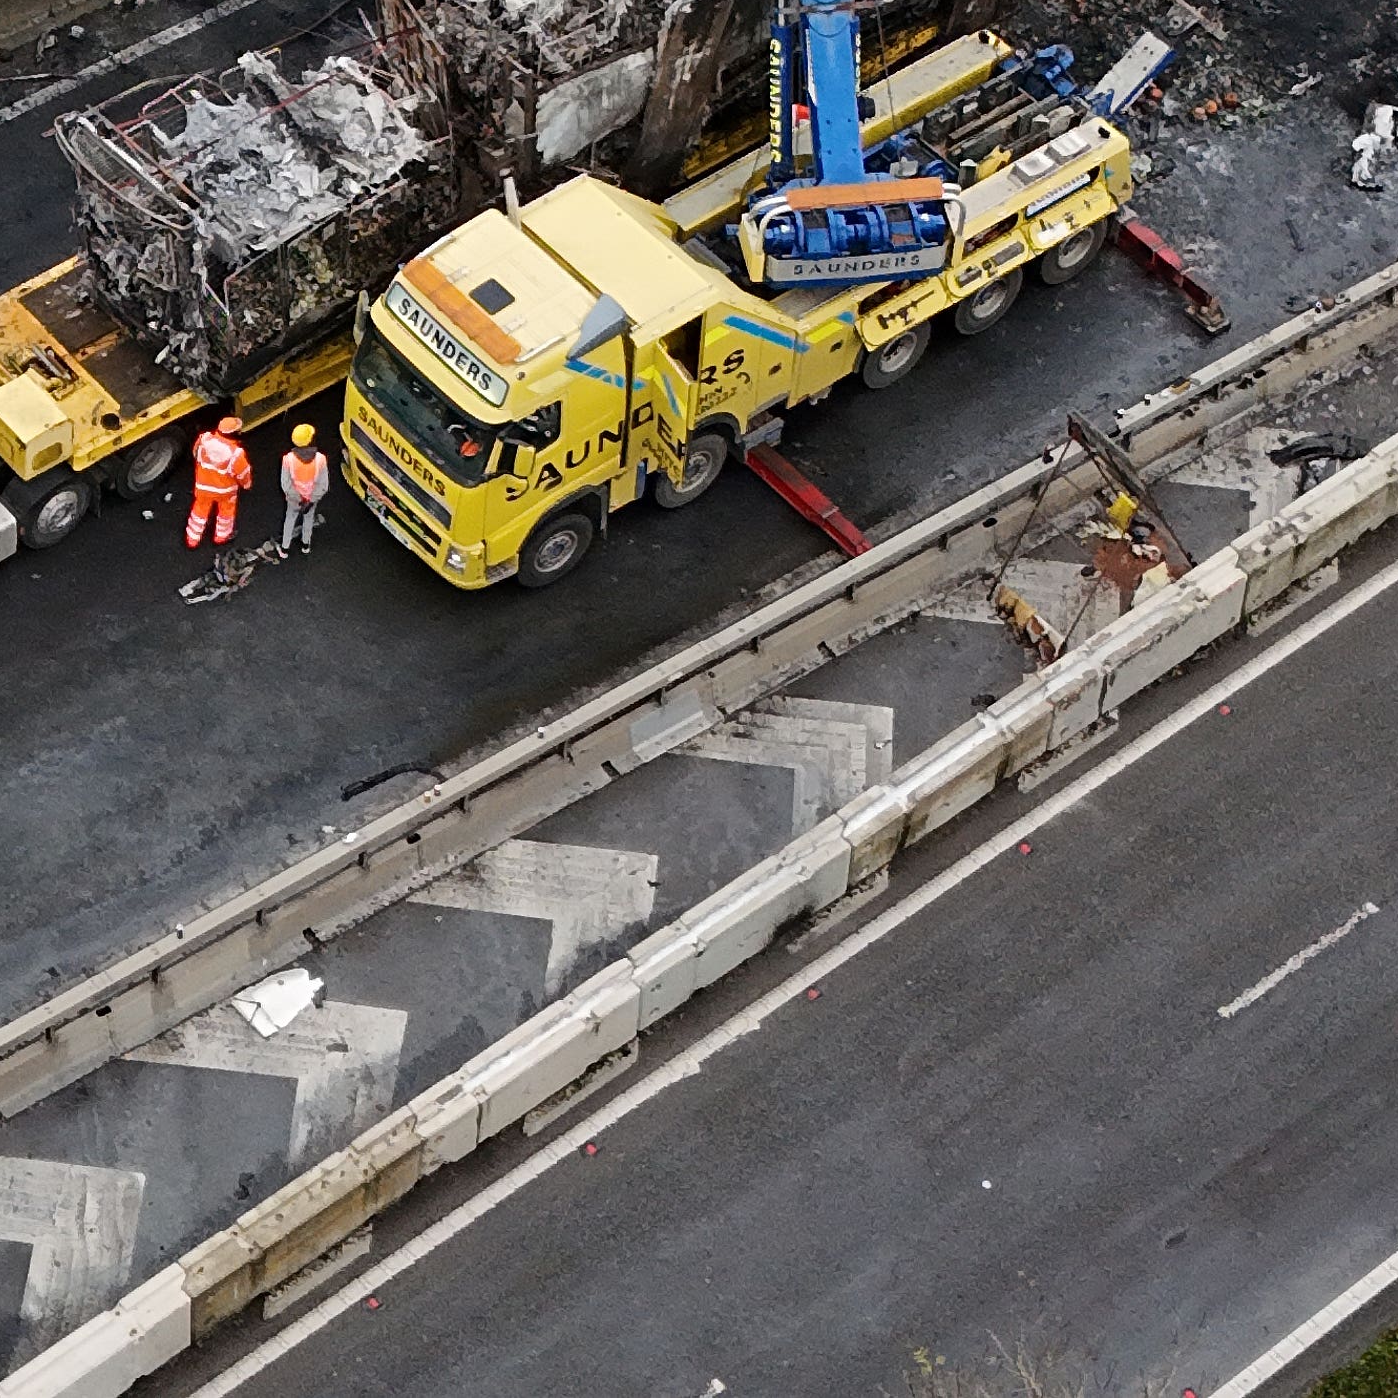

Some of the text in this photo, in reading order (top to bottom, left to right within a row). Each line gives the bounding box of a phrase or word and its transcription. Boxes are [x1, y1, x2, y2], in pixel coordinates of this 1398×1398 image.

[792, 253, 921, 276] SAUNDERS
[398, 298, 493, 391] SAUNDERS
[357, 405, 446, 497] SAUNDERS
